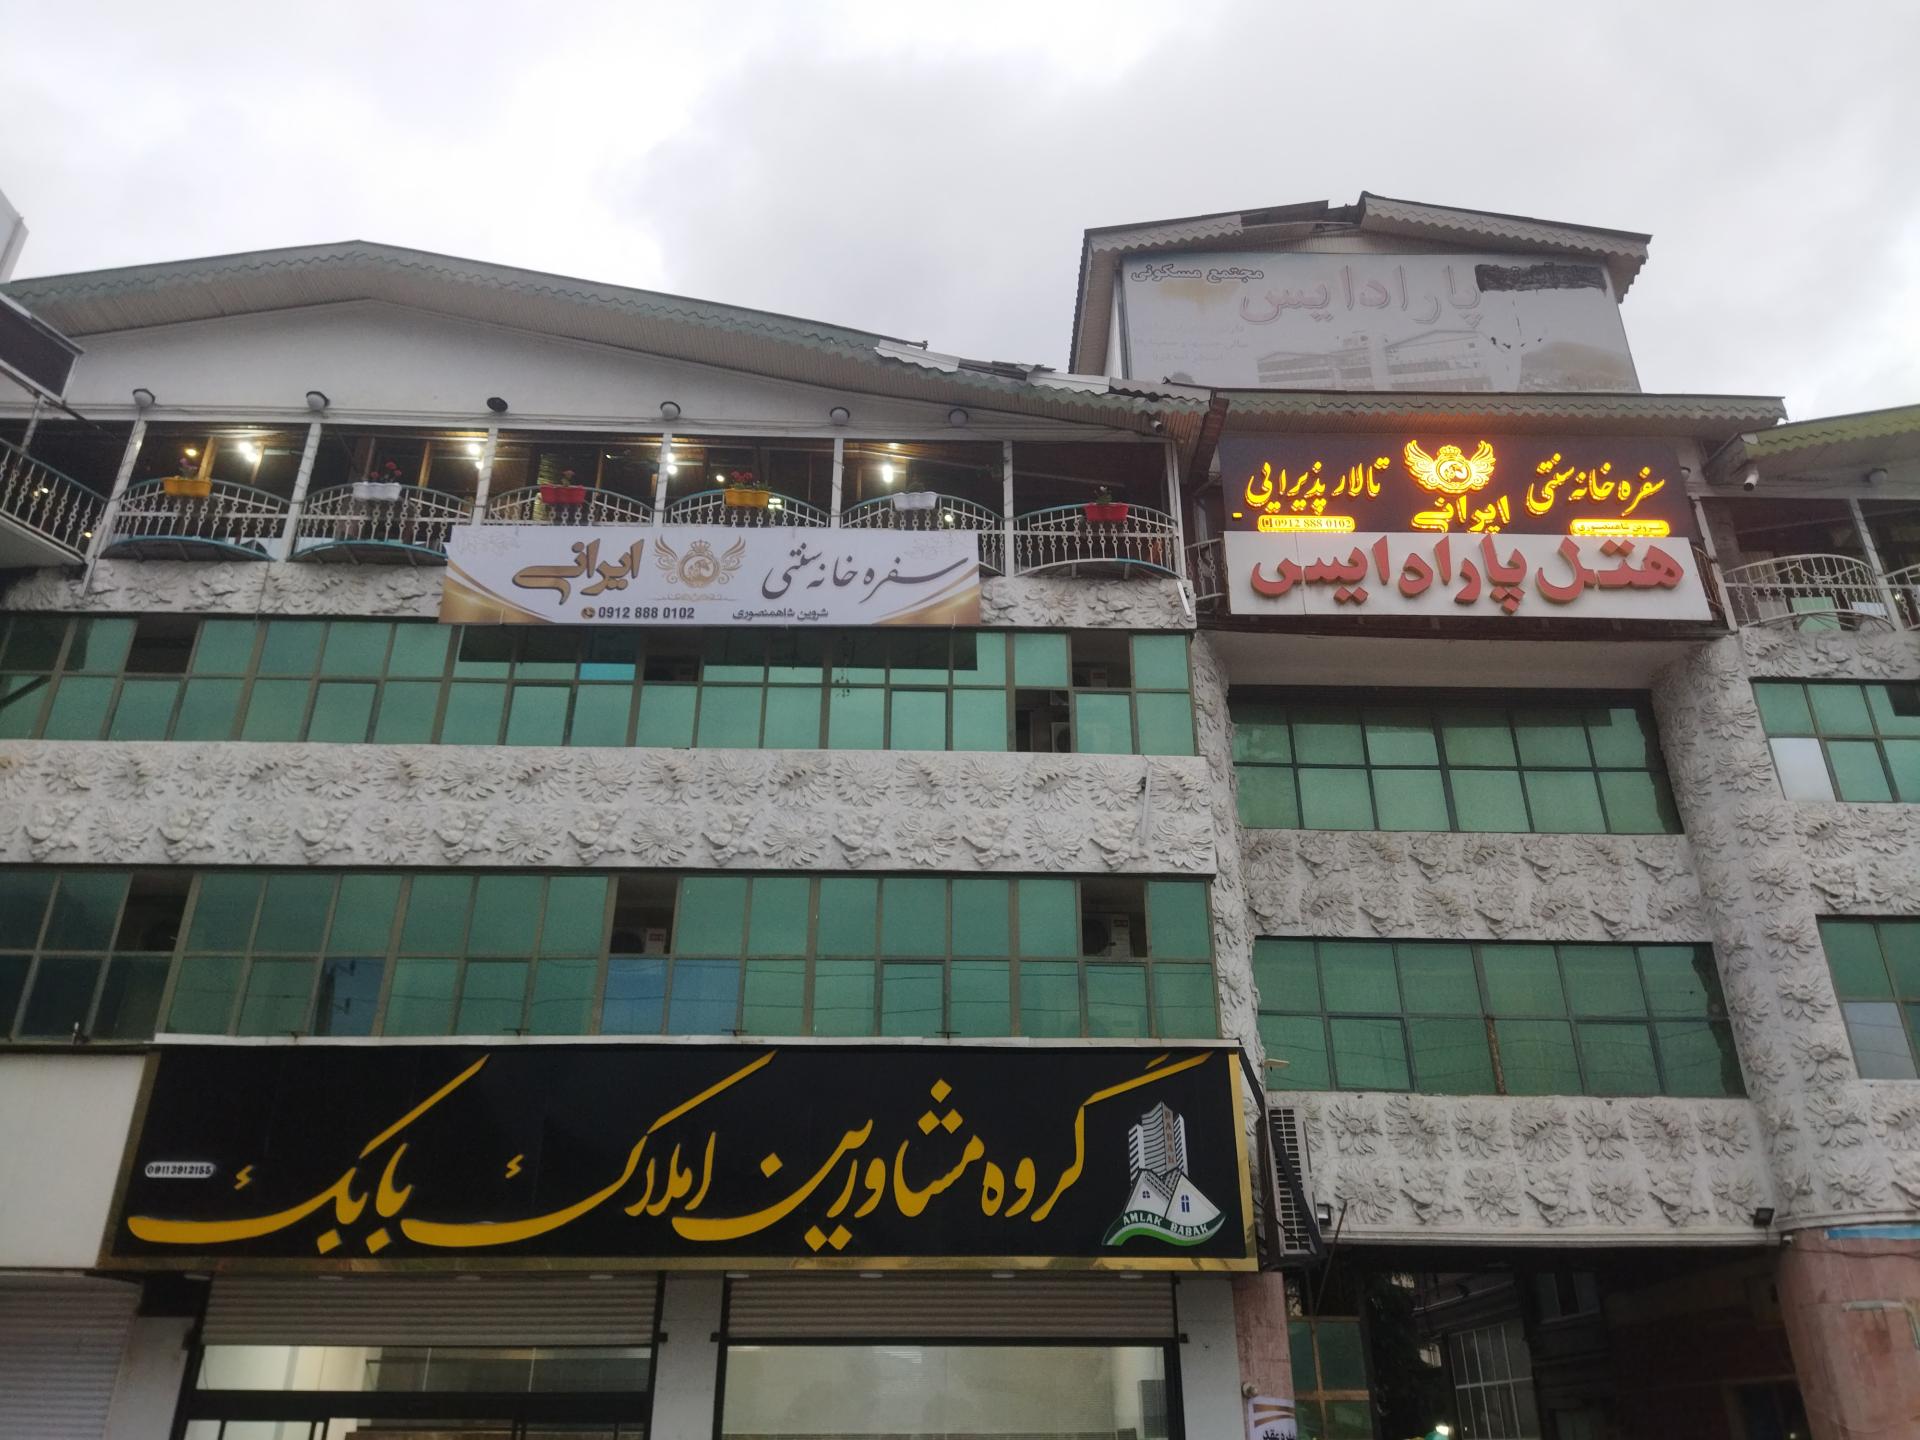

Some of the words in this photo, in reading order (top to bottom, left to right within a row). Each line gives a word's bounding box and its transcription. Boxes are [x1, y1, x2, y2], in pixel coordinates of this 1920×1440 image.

[1130, 263, 1203, 283] مسکونی
[1206, 265, 1265, 283] مجتمع
[1244, 461, 1327, 515] پذیرایی
[1331, 456, 1390, 498] تالار
[1525, 453, 1575, 515] سنتی
[1568, 462, 1616, 501] خانه
[1617, 466, 1665, 517] سفره
[1274, 518, 1300, 529] 0912
[1303, 518, 1323, 529] 888
[1325, 518, 1352, 529] 0102
[1410, 494, 1511, 534] ایرانی
[511, 538, 645, 606] ایرانی
[761, 542, 823, 600] سنتی
[806, 555, 859, 590] خانه
[858, 556, 970, 604] سفره
[1250, 533, 1528, 615] پارادایس
[1535, 536, 1685, 604] هتل
[598, 606, 631, 620] 0912
[634, 606, 660, 620] 888
[662, 606, 696, 620] 0102
[796, 607, 829, 622] شروین
[126, 1053, 490, 1255] بابک
[399, 1050, 778, 1248] املاک
[980, 1051, 1214, 1222] گروه
[671, 1079, 986, 1252] مشاورین
[1122, 1211, 1164, 1228] AMLAK
[1169, 1221, 1209, 1237] BABAK
